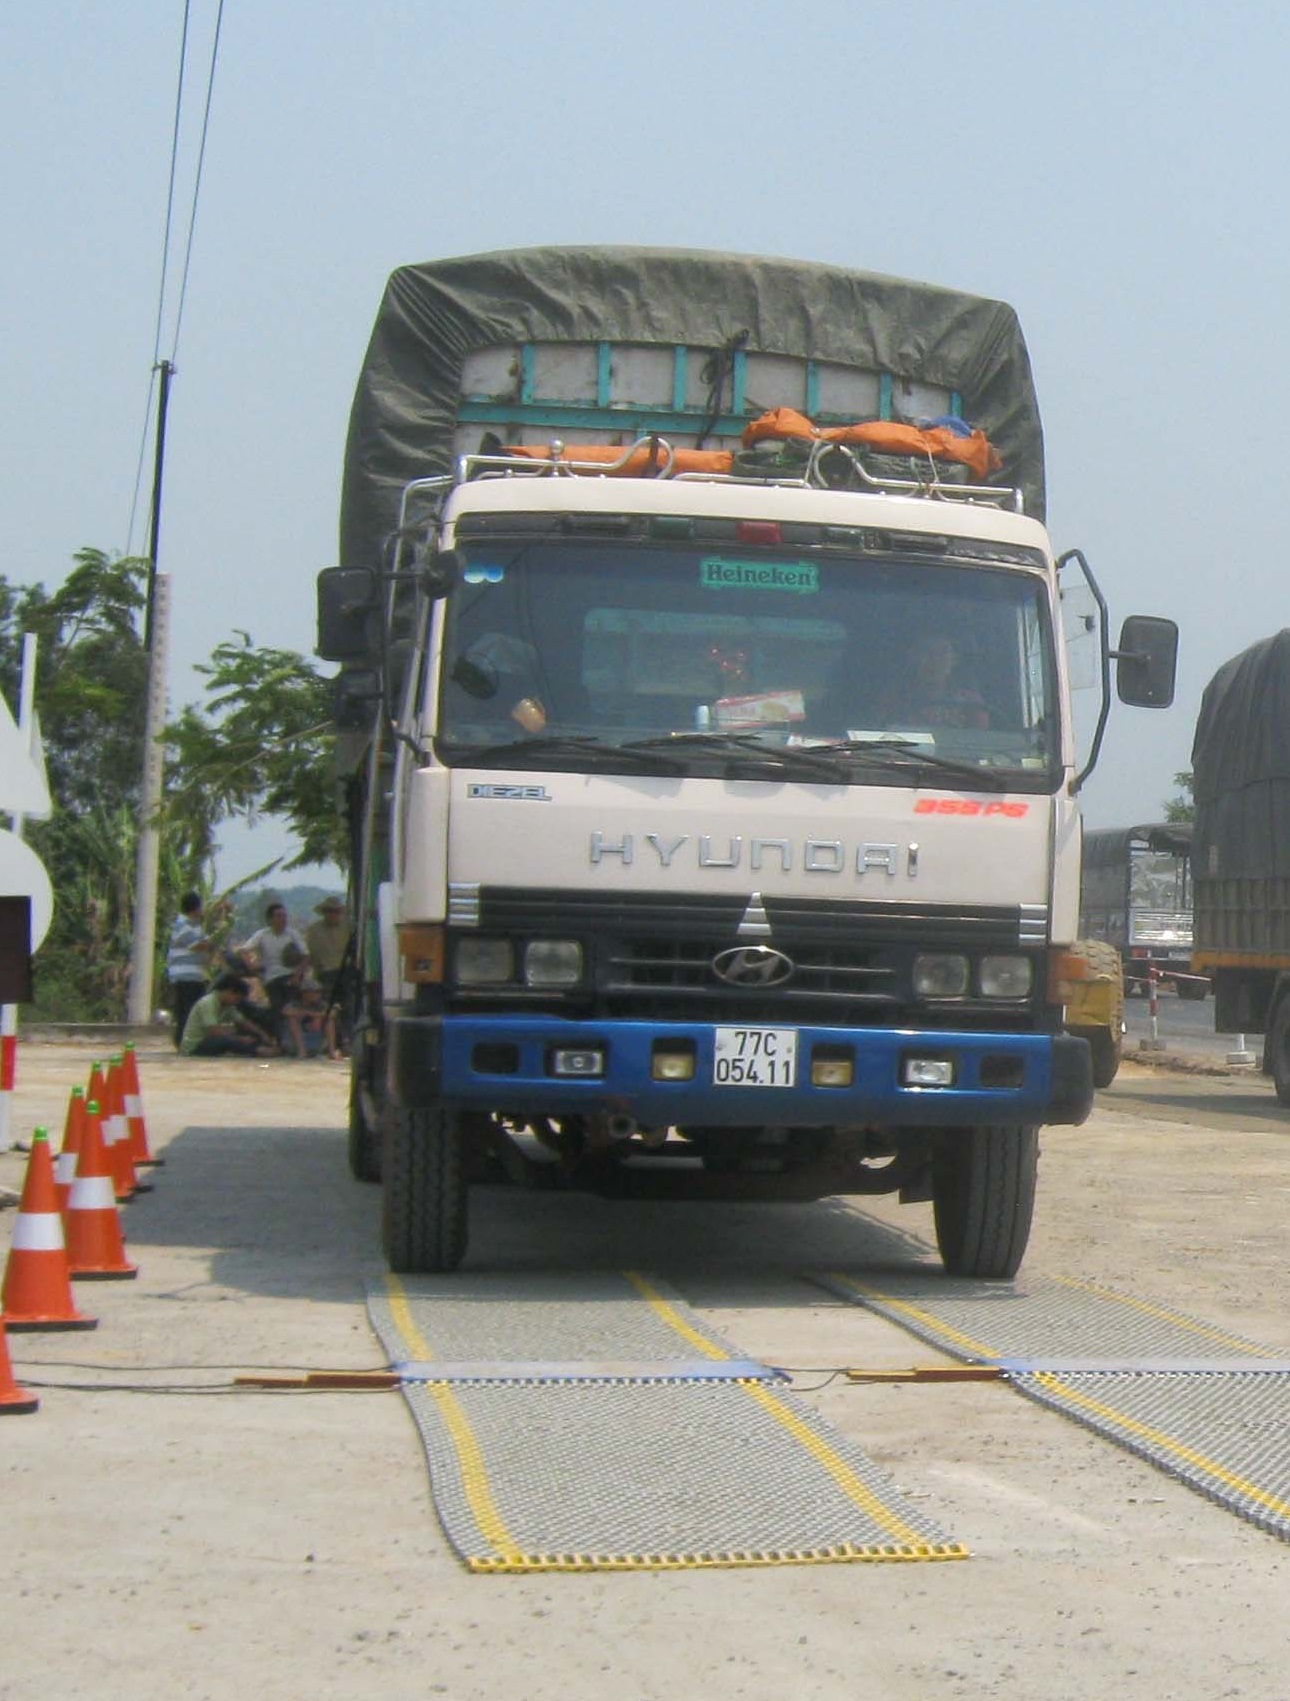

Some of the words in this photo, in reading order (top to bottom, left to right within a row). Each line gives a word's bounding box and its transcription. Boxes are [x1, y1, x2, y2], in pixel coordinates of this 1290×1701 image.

[706, 564, 813, 586] Heineken
[590, 831, 919, 877] HYUNDAI
[734, 1031, 777, 1057] 77C
[716, 1058, 791, 1085] 054.11
